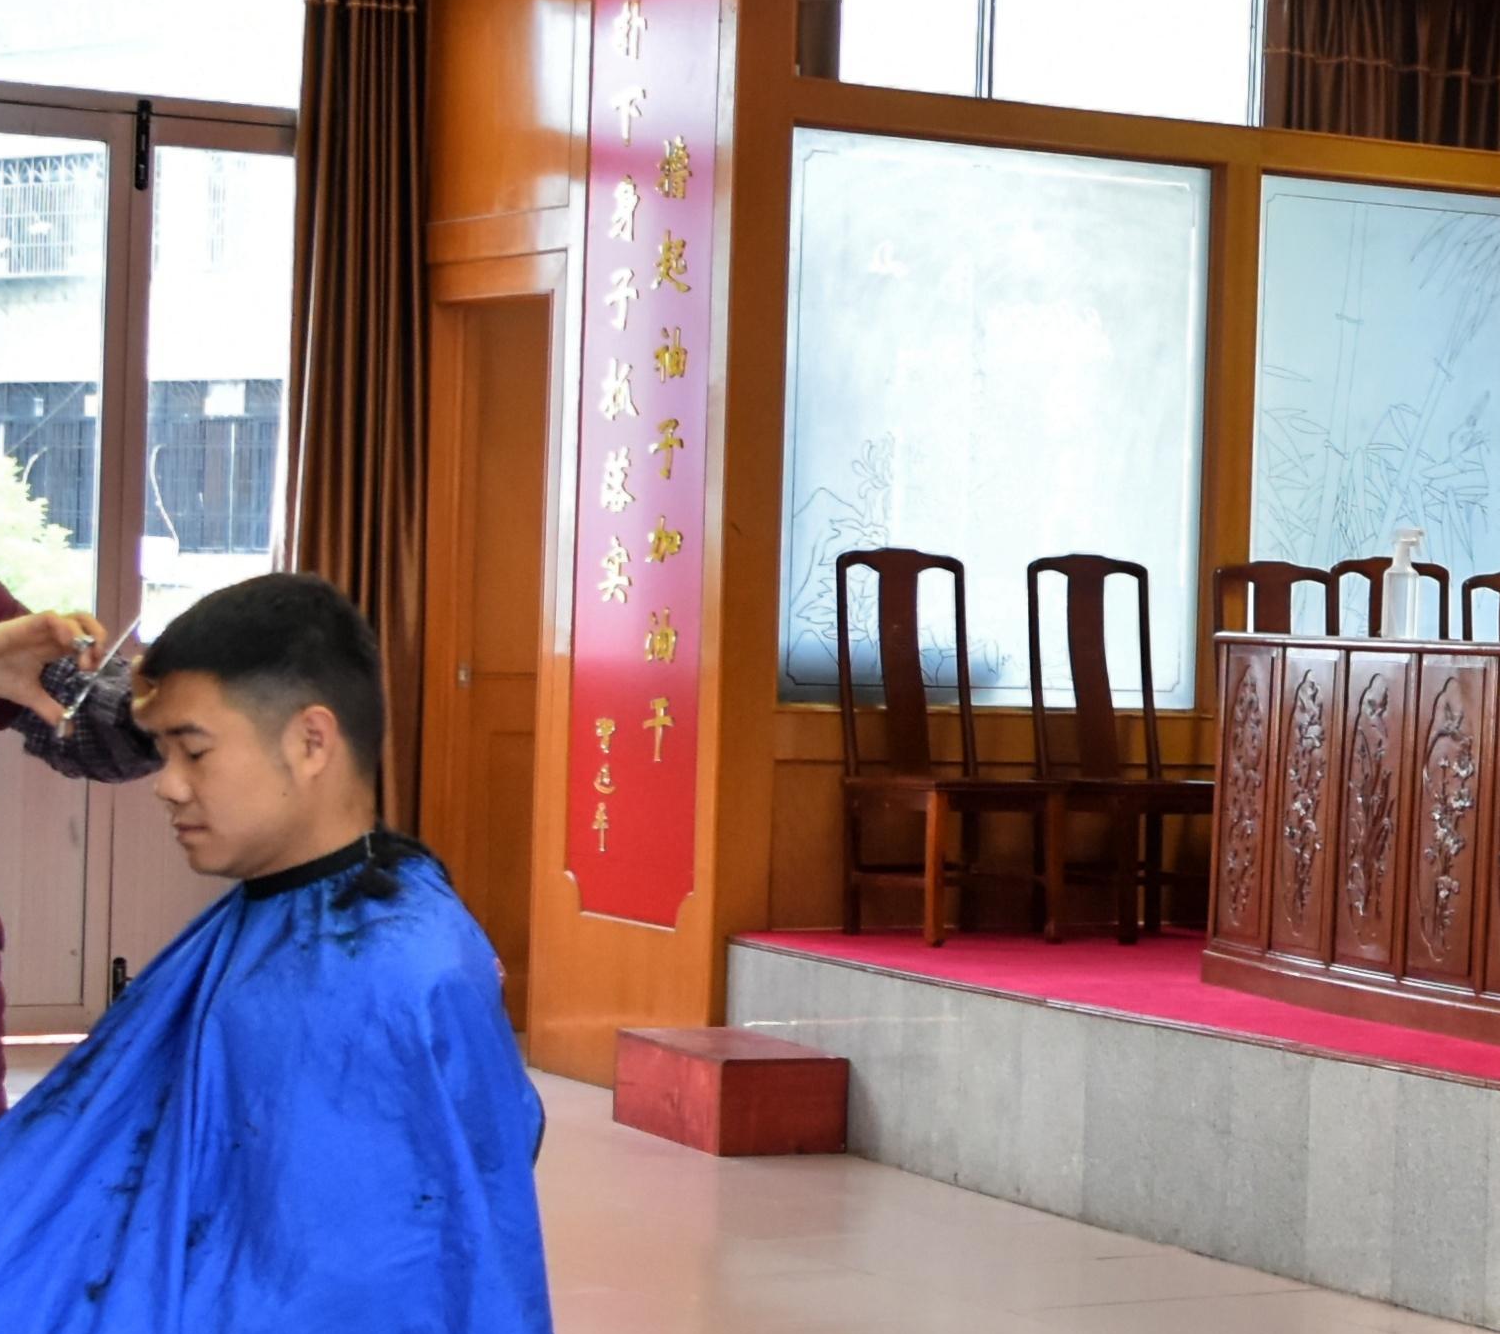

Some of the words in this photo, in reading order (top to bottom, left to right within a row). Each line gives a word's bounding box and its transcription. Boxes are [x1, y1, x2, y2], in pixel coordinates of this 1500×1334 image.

[642, 134, 693, 763] 撸起袖子加油干
